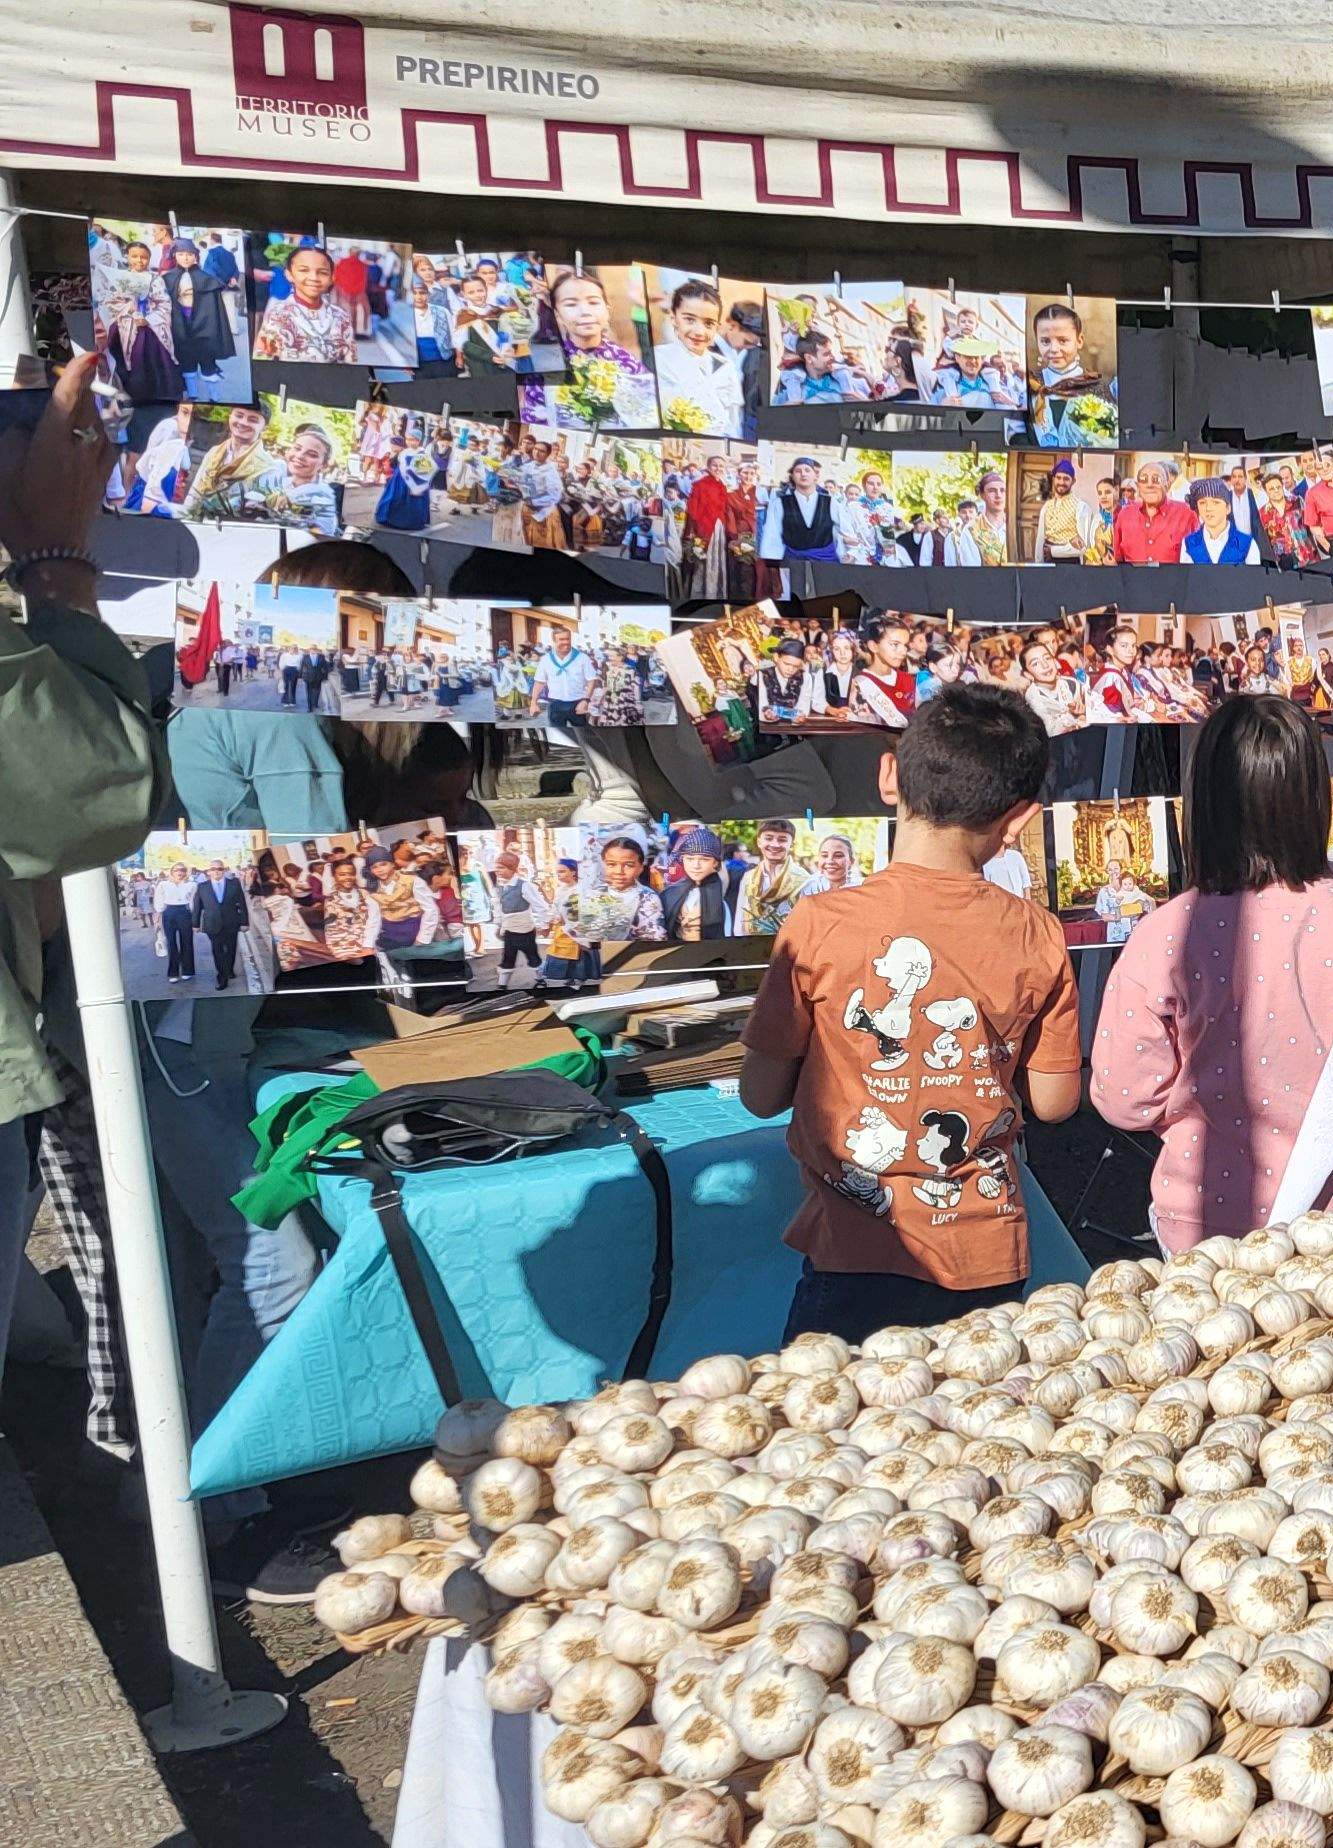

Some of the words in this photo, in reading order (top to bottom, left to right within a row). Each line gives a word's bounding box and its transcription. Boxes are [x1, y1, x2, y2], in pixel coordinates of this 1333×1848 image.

[395, 54, 601, 100] PREPIRINEO
[237, 113, 372, 142] MUSEO
[920, 1073, 963, 1089] SNOOPY
[931, 1212, 959, 1226] LUCY
